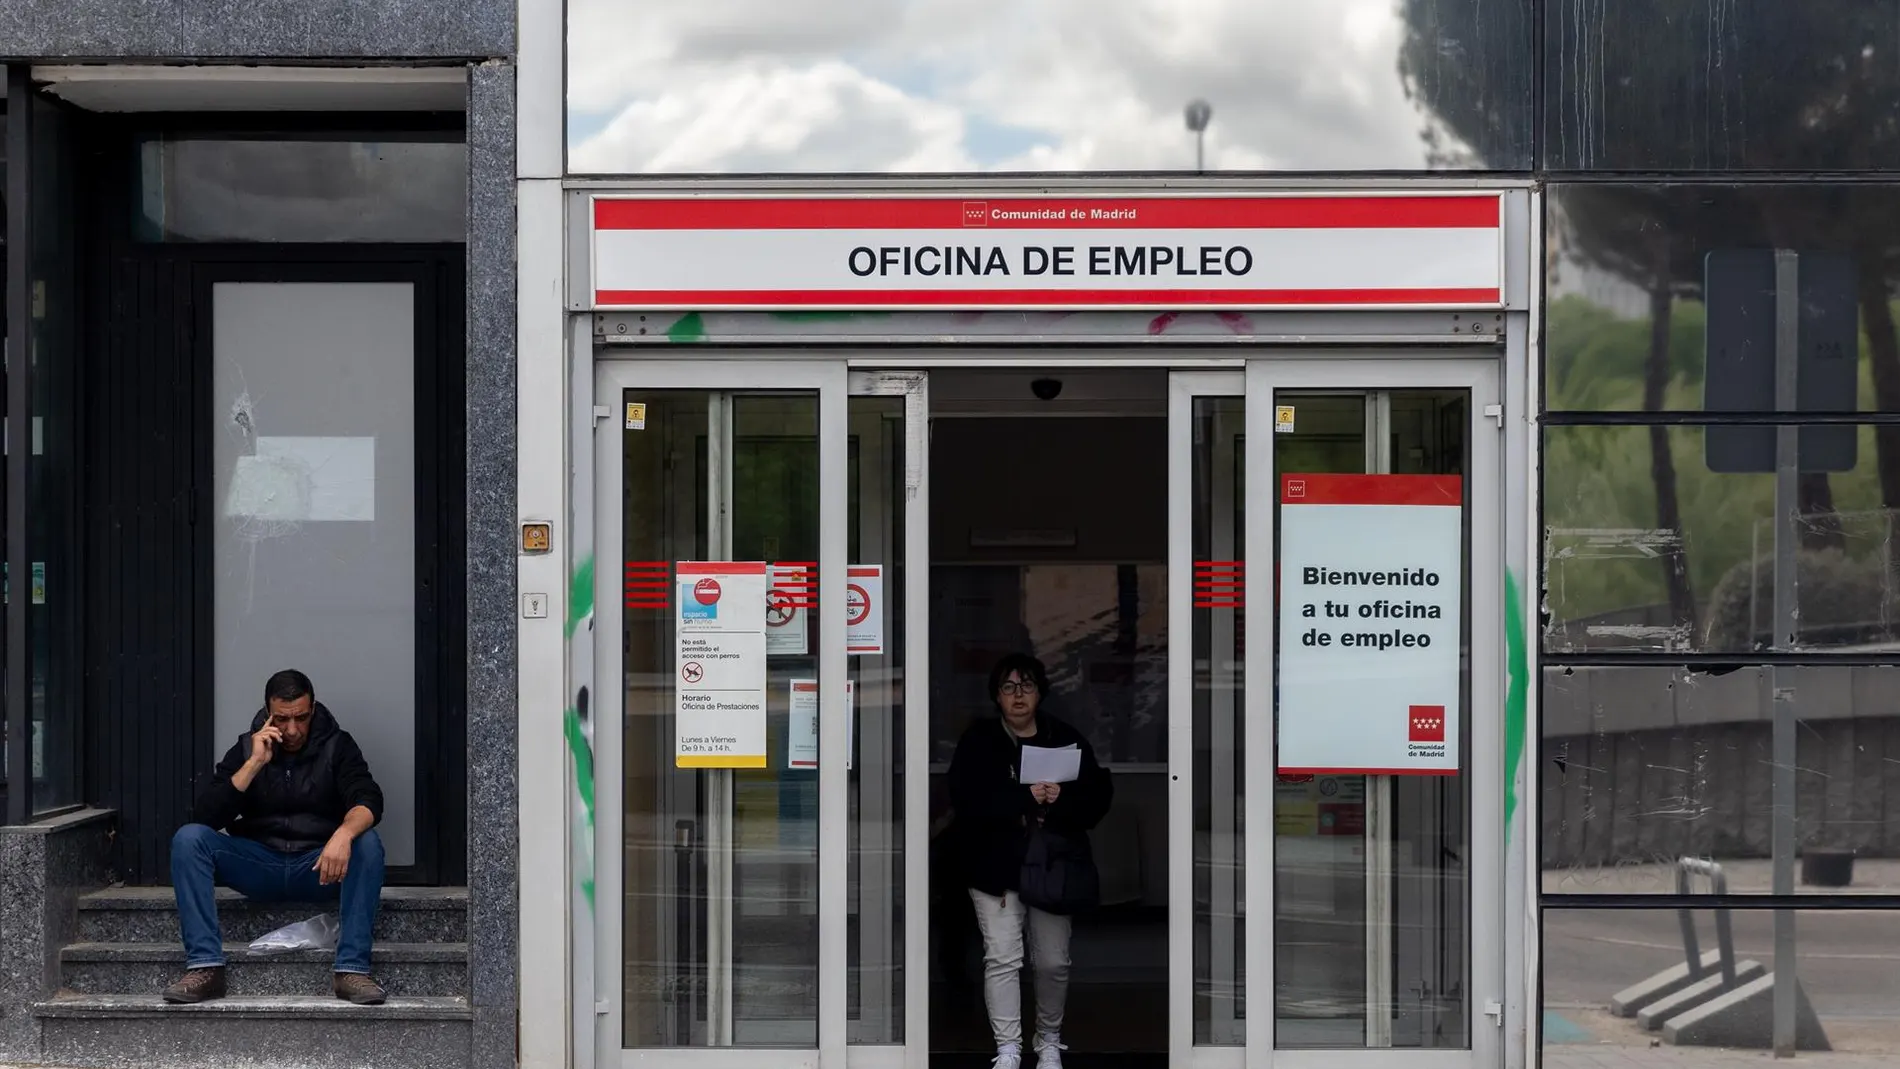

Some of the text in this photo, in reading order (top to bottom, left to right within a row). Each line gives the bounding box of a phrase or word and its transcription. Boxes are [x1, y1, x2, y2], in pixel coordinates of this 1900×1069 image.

[991, 208, 1137, 220] Comunidad de Madrid
[848, 245, 1253, 277] OFICINA DE EMPLEO
[1303, 566, 1440, 587] Bienvenido
[1302, 599, 1441, 619] a tu oficina
[1302, 628, 1431, 651] de empleo
[681, 694, 712, 702] Horario
[681, 702, 760, 711] Oficina de Prestaciones
[681, 736, 703, 744] Lunes
[710, 736, 737, 744] Viernes
[681, 744, 692, 752] De
[692, 744, 699, 752] 9
[699, 744, 707, 752] h.
[715, 744, 724, 752] 14
[724, 744, 732, 752] h.
[1419, 750, 1445, 758] Madrid
